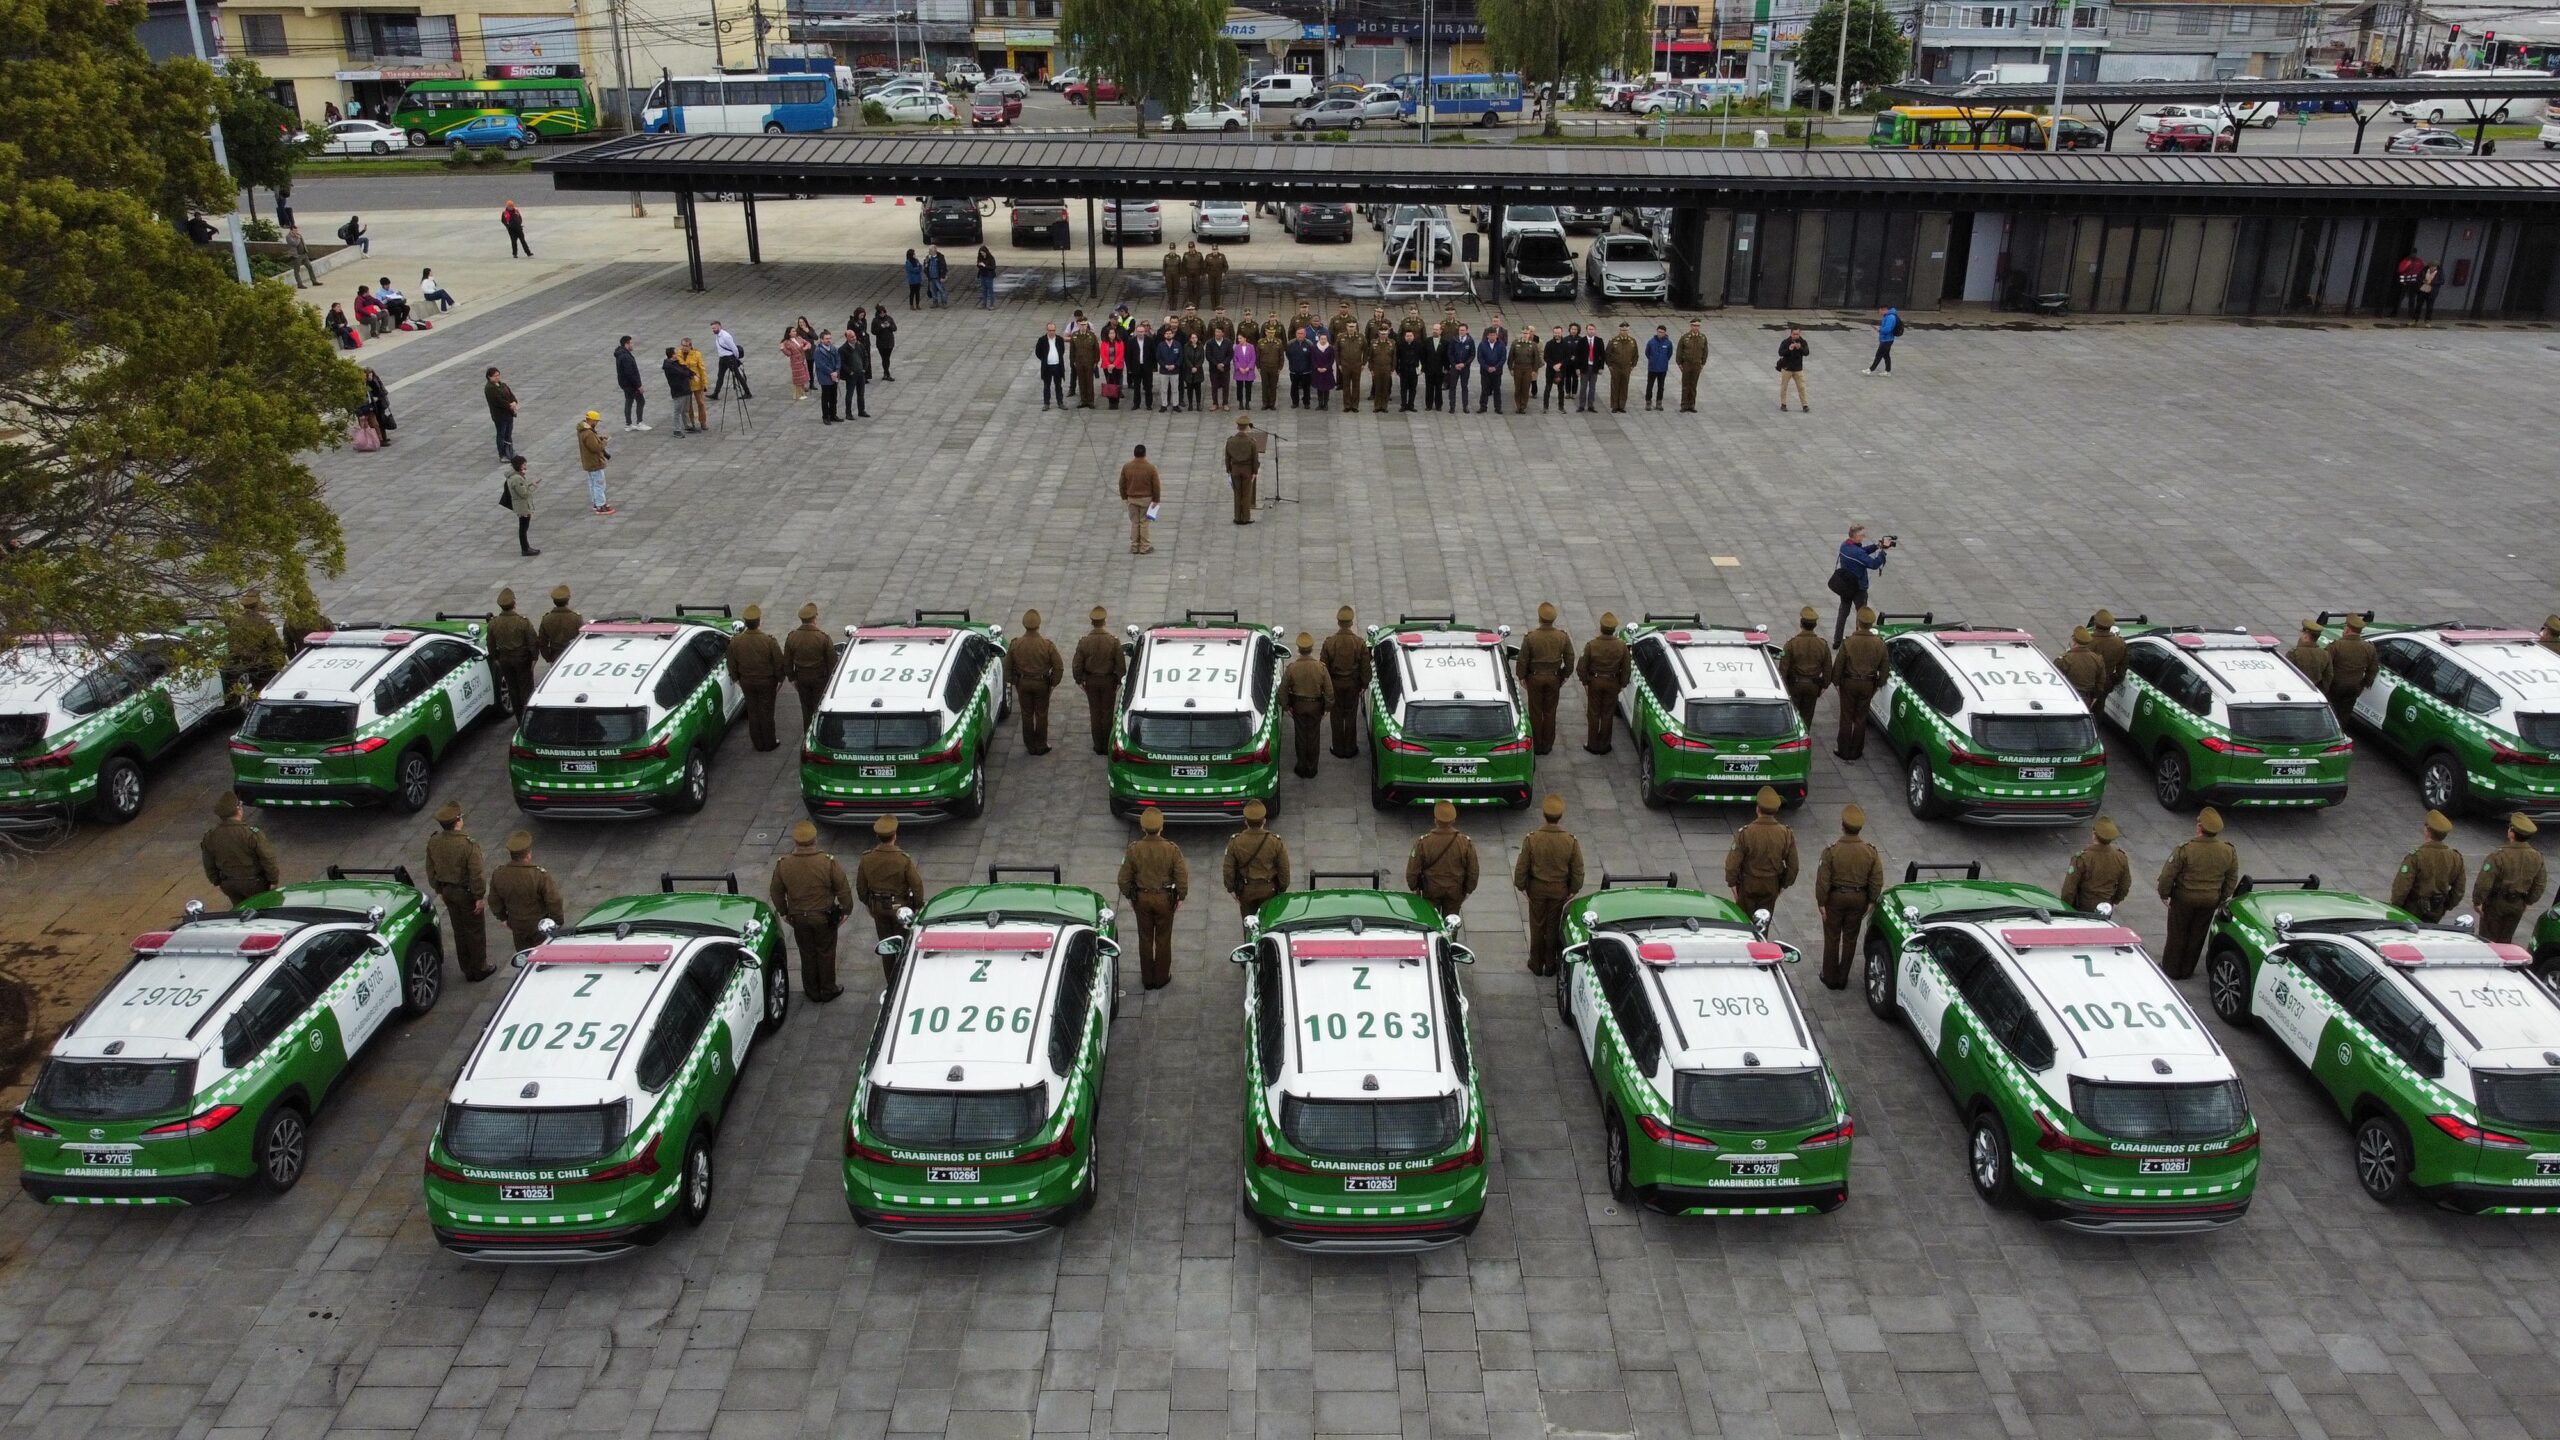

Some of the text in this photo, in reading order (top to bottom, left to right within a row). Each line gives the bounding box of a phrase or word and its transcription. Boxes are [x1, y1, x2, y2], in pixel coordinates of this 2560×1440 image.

[510, 65, 557, 76] Shaddai
[612, 639, 633, 651] Z
[890, 644, 908, 656] Z
[1192, 644, 1206, 656] Z
[1983, 647, 2006, 659] Z
[2493, 646, 2522, 658] Z
[307, 658, 366, 670] Z 9791
[1424, 657, 1476, 668] Z 9646
[1703, 661, 1754, 672] Z 9677
[2219, 660, 2275, 671] Z 9680
[559, 662, 650, 678] 10265
[847, 667, 934, 683] 10283
[1152, 667, 1238, 683] 10275
[1971, 671, 2063, 686] 10262
[535, 748, 621, 757] CARABINEROS DE CHILE
[833, 753, 920, 762] CARABINEROS DE CHILE
[1147, 753, 1232, 762] CARABINEROS DE CHILE
[1998, 755, 2050, 763] CARABINEROS
[969, 959, 992, 982] Z
[2072, 954, 2106, 977] Z
[1352, 967, 1372, 990] Z
[351, 966, 384, 1011] Z 9705
[573, 974, 603, 997] Z
[122, 987, 209, 1007] Z 9705
[2269, 977, 2305, 1020] Z 9737
[2449, 988, 2534, 1008] Z 9737
[1692, 997, 1770, 1018] Z 9678
[347, 1003, 380, 1042] CARABINEROS
[908, 1005, 1032, 1035] 10266
[2062, 1001, 2192, 1032] 10261
[1304, 1011, 1431, 1042] 10263
[499, 1021, 628, 1051] 10252
[2110, 1141, 2230, 1153] CARABINEROS DE CHILE
[105, 1154, 132, 1163] 9705
[891, 1150, 1015, 1162] CARABINEROS DE CHILE
[1311, 1158, 1434, 1171] CARABINEROS DE CHILE
[1753, 1164, 1779, 1173] 9678
[2160, 1162, 2186, 1171] 10261
[65, 1168, 158, 1177] CARABINEROS DE CHILE
[462, 1168, 590, 1180] CARABINEROS DE CHILE
[949, 1171, 976, 1180] 10266
[1366, 1180, 1393, 1189] 10263
[1708, 1177, 1800, 1188] CARABINEROS DE CHILE
[522, 1189, 548, 1198] 10252
